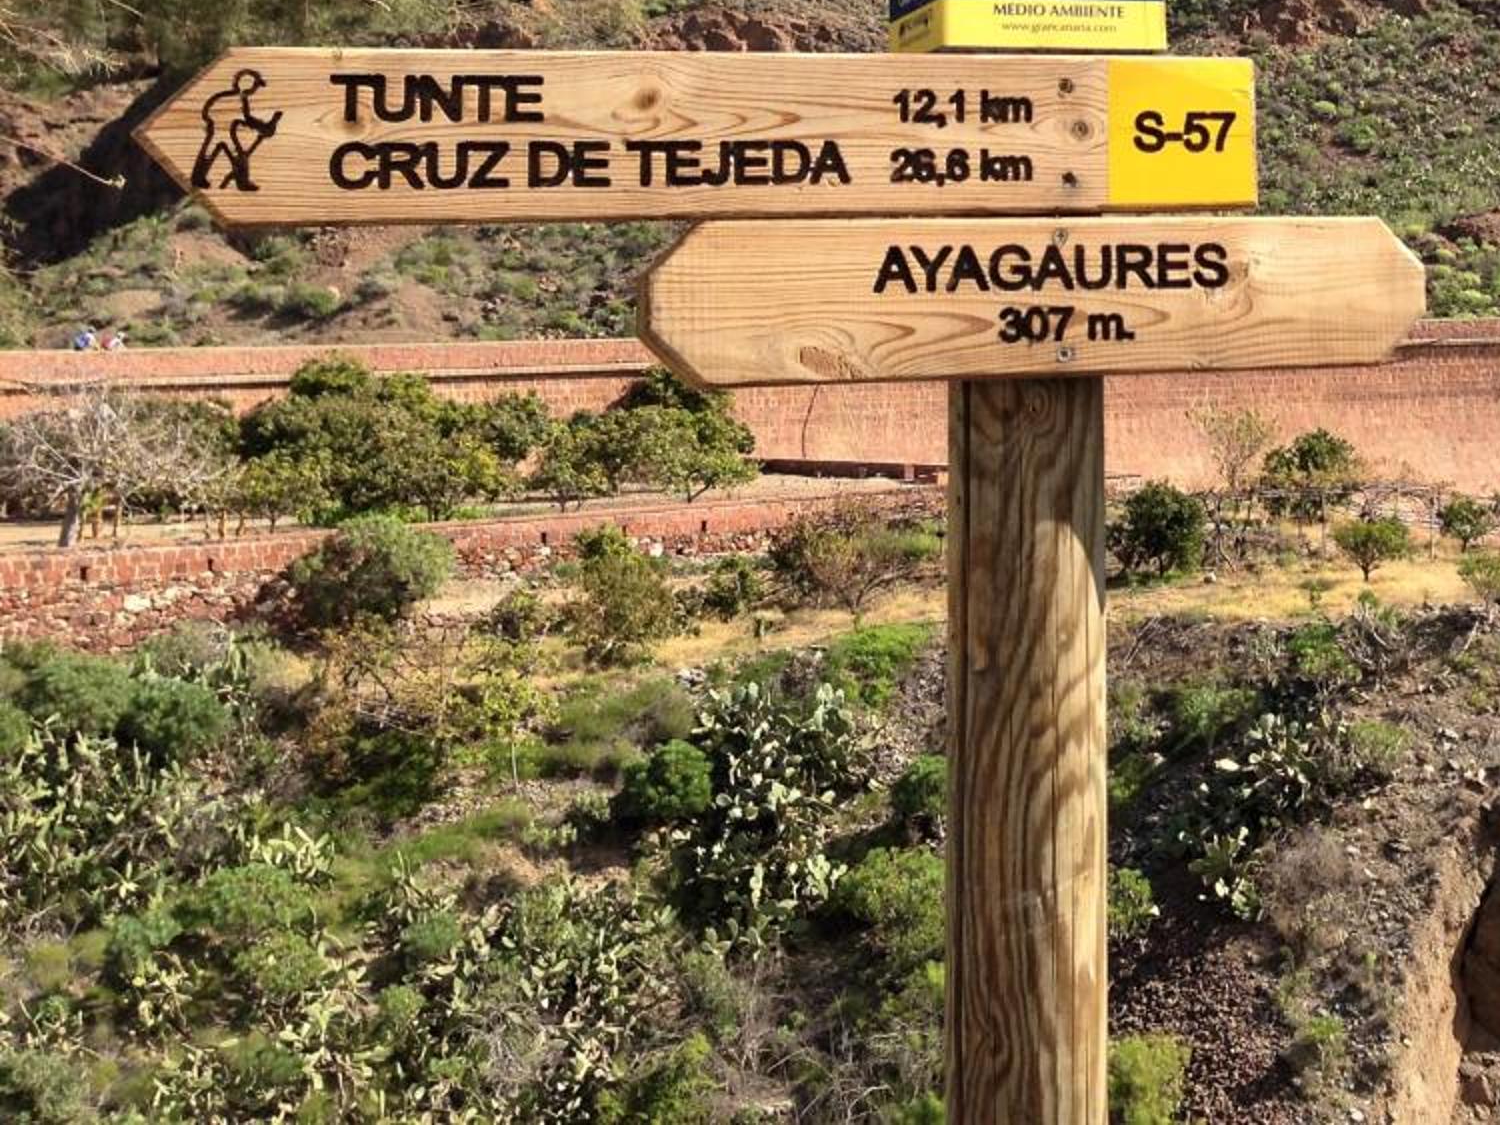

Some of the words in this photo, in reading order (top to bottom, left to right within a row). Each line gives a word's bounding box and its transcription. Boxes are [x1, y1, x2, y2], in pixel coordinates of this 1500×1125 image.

[993, 2, 1046, 16] MEDIO
[1049, 4, 1125, 19] AMBIENTE
[1001, 21, 1117, 34] www.grancanaria.com
[329, 75, 544, 123] TUNTE
[893, 88, 965, 128] 12,1
[979, 88, 1033, 124] km
[1133, 110, 1237, 153] S-57
[329, 140, 510, 190] CRUZ
[526, 140, 612, 188] DE
[627, 139, 851, 186] TEJEDA
[890, 148, 970, 187] 26,6
[979, 148, 1033, 182] km
[873, 243, 1230, 294] AYAGAURES
[998, 305, 1075, 344] 307
[1087, 311, 1135, 341] m.
